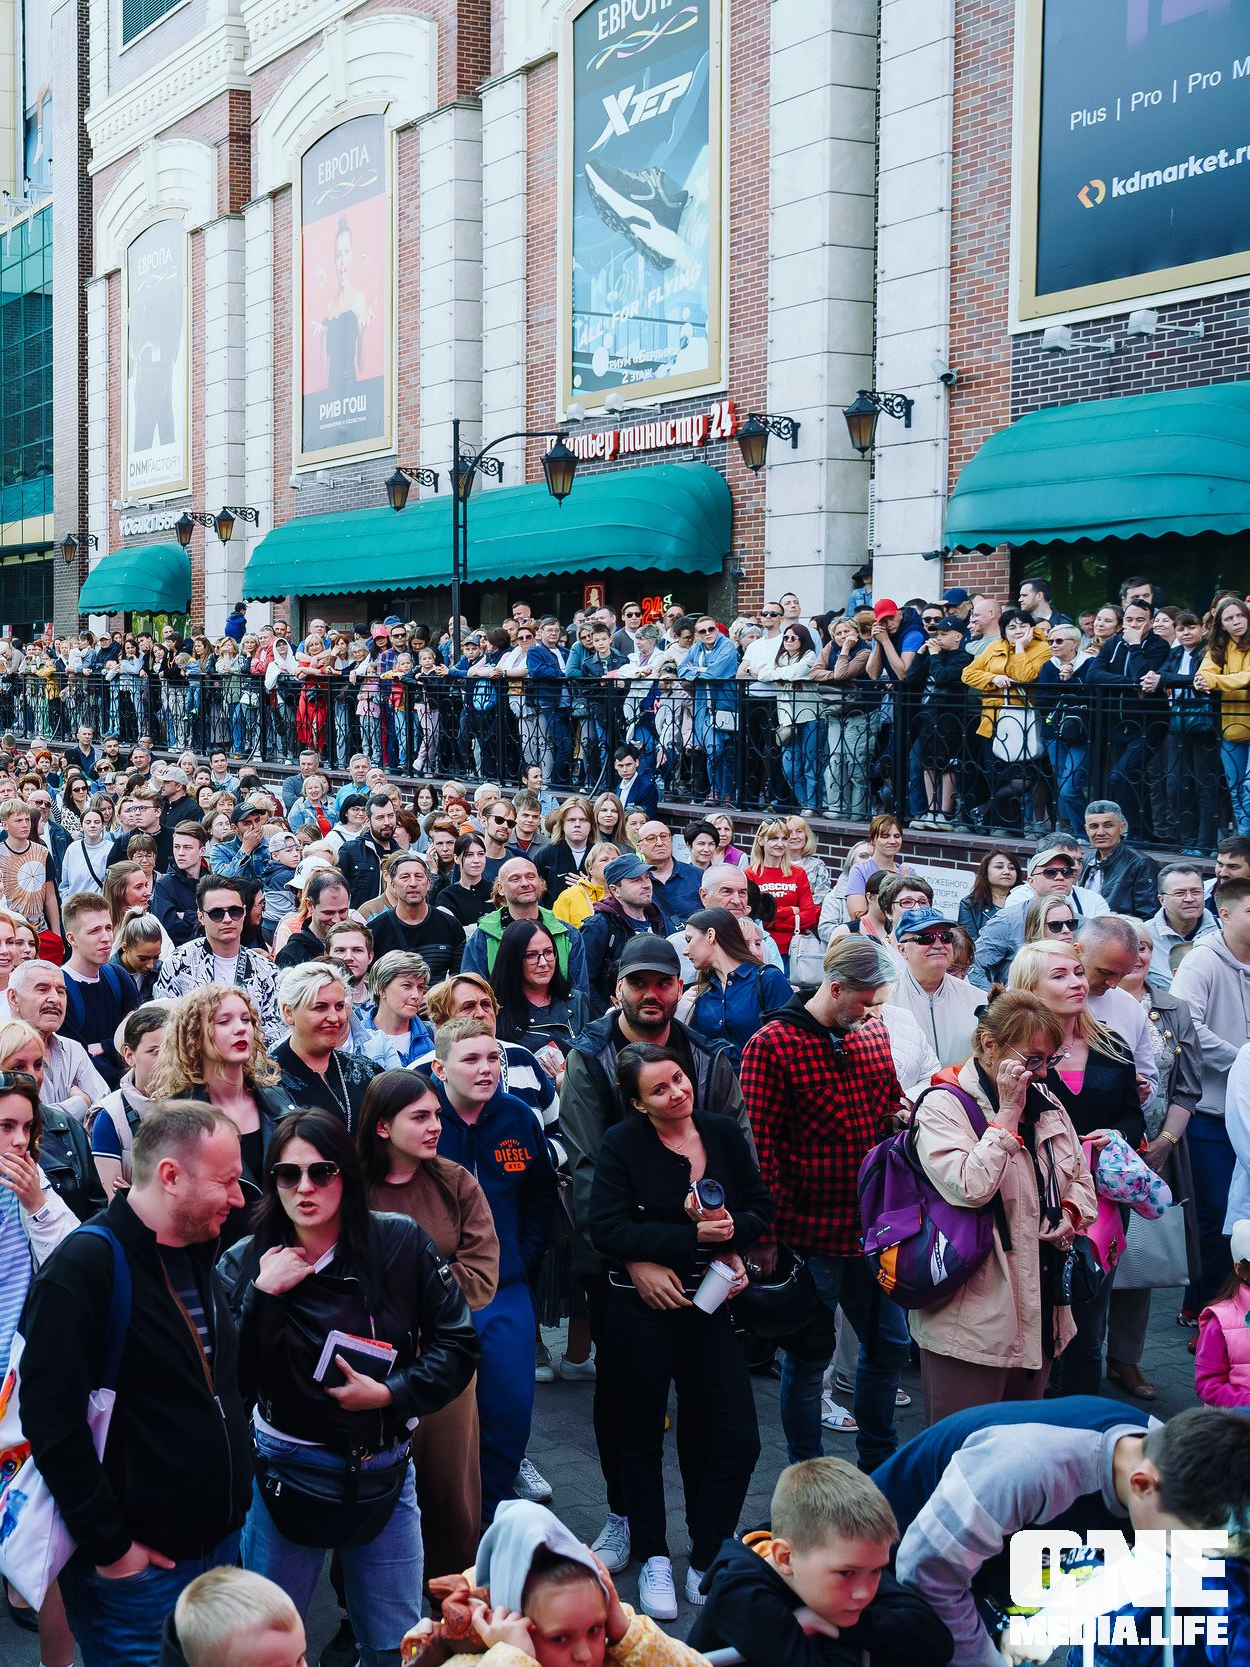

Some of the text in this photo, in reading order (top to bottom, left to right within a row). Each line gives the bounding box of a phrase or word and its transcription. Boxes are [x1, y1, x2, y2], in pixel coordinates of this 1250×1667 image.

[597, 0, 672, 41] ЕВРО
[587, 70, 694, 153] XTEP
[1069, 105, 1107, 131] Plus
[1130, 89, 1163, 112] Pro
[1187, 70, 1222, 94] Pro
[317, 143, 370, 186] ЕВРОПА
[137, 244, 173, 277] ЕВРОПА
[578, 321, 604, 349] ALL
[611, 300, 640, 328] FOR
[621, 371, 629, 384] 2
[319, 394, 367, 420] РИВ ГОШ
[619, 414, 706, 455] министр
[710, 400, 736, 439] 24
[129, 455, 182, 478] DNMFACTORY
[493, 1147, 533, 1163] DIESEL
